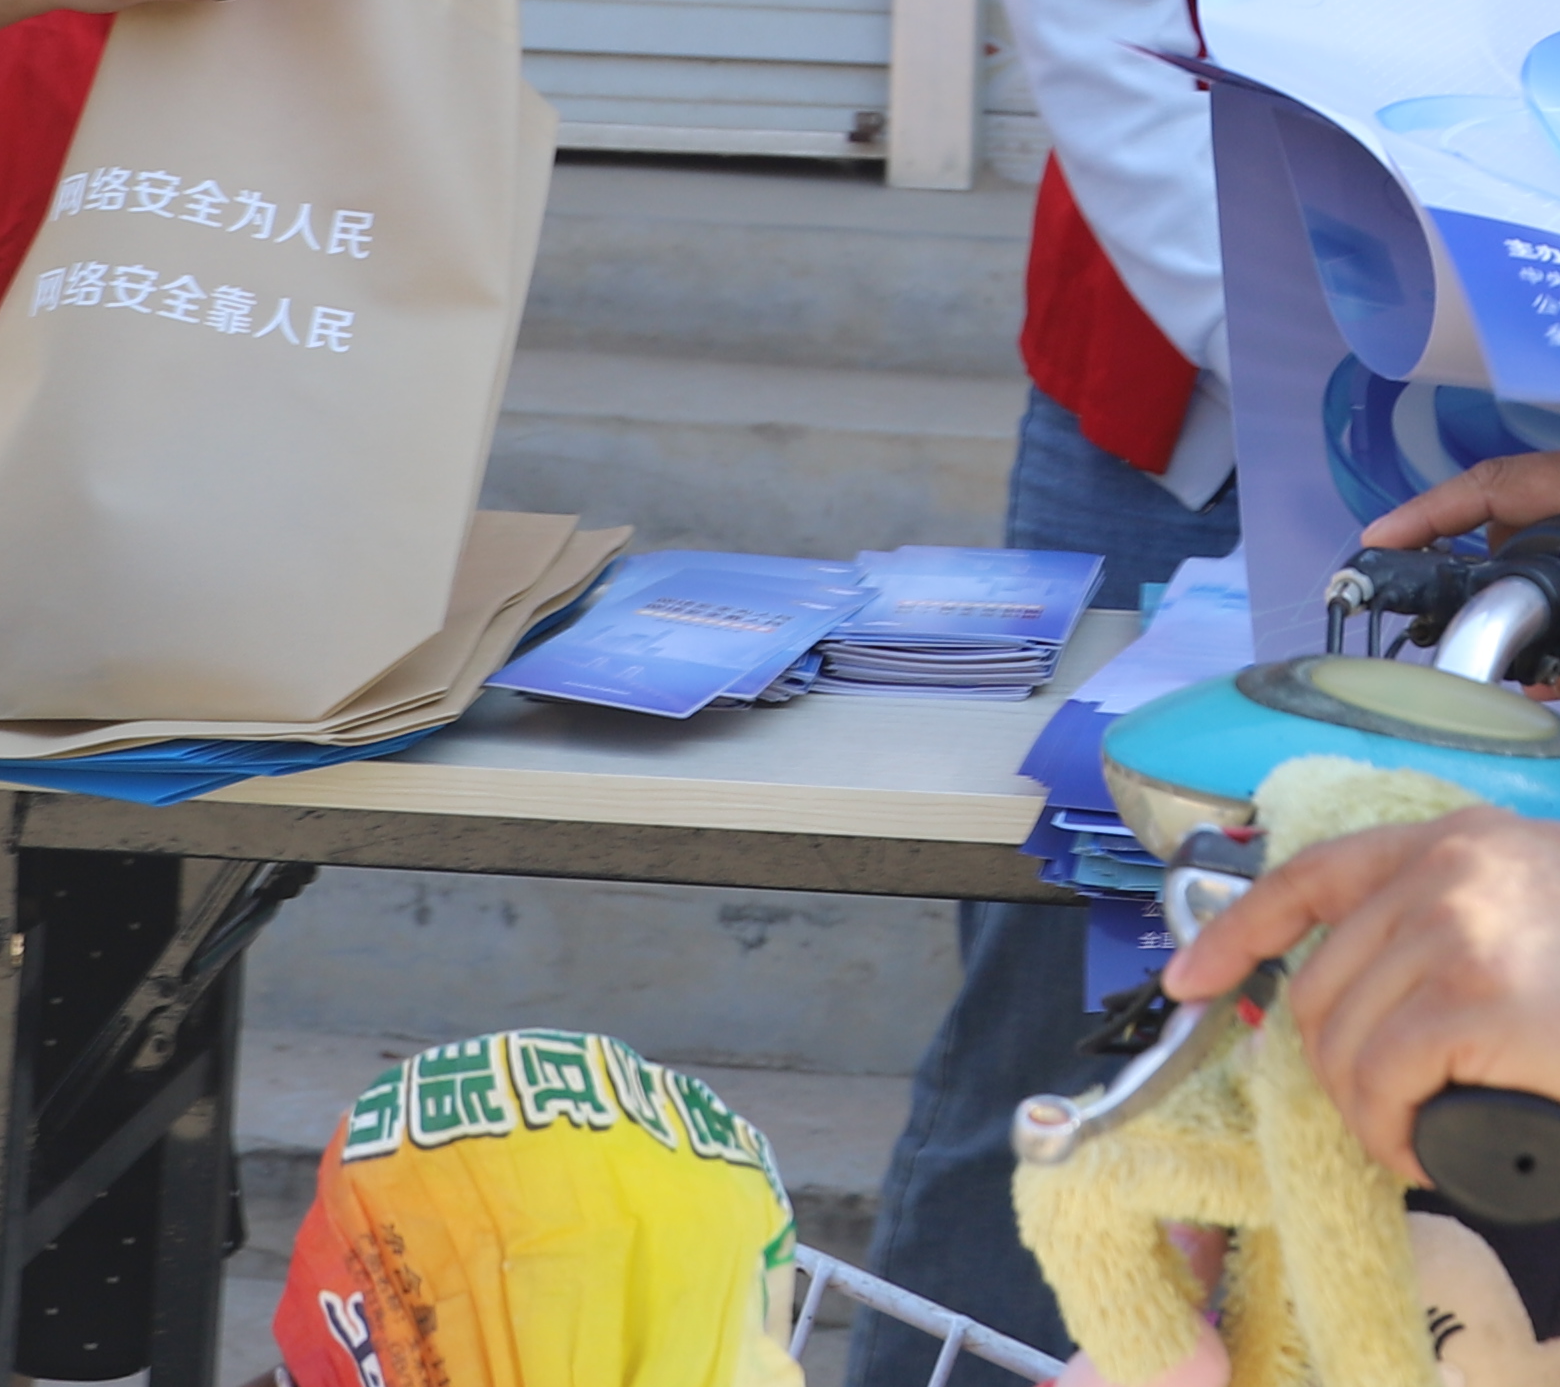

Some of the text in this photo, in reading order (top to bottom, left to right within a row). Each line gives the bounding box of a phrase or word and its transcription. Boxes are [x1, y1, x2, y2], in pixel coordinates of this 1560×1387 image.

[48, 165, 376, 260] 网络安全为人民
[28, 260, 357, 353] 网络安全靠人民
